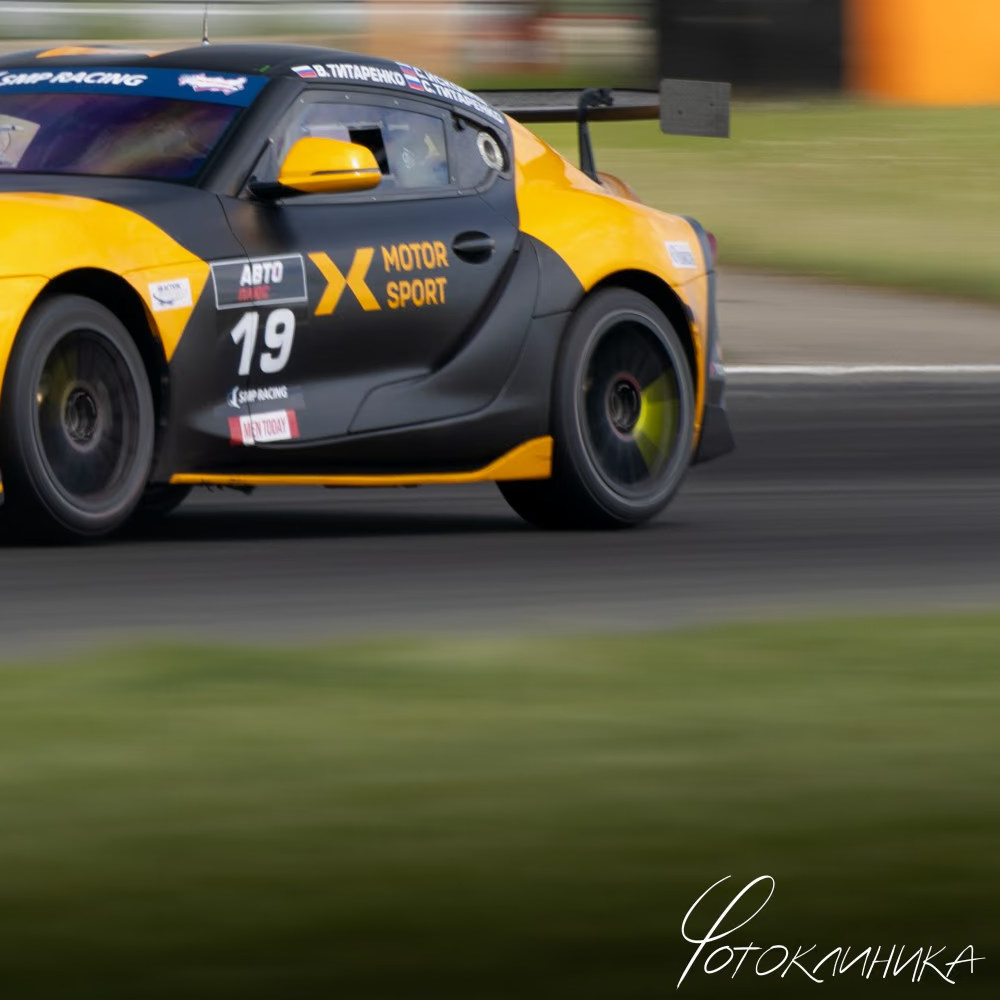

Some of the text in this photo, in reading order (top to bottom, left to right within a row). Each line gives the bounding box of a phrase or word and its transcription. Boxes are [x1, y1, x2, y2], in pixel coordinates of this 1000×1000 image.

[51, 71, 148, 87] RACING
[381, 241, 449, 274] MOTOR
[386, 277, 448, 309] SPORT
[230, 308, 296, 376] 19
[257, 385, 288, 401] RACING
[263, 417, 286, 436] TODAY
